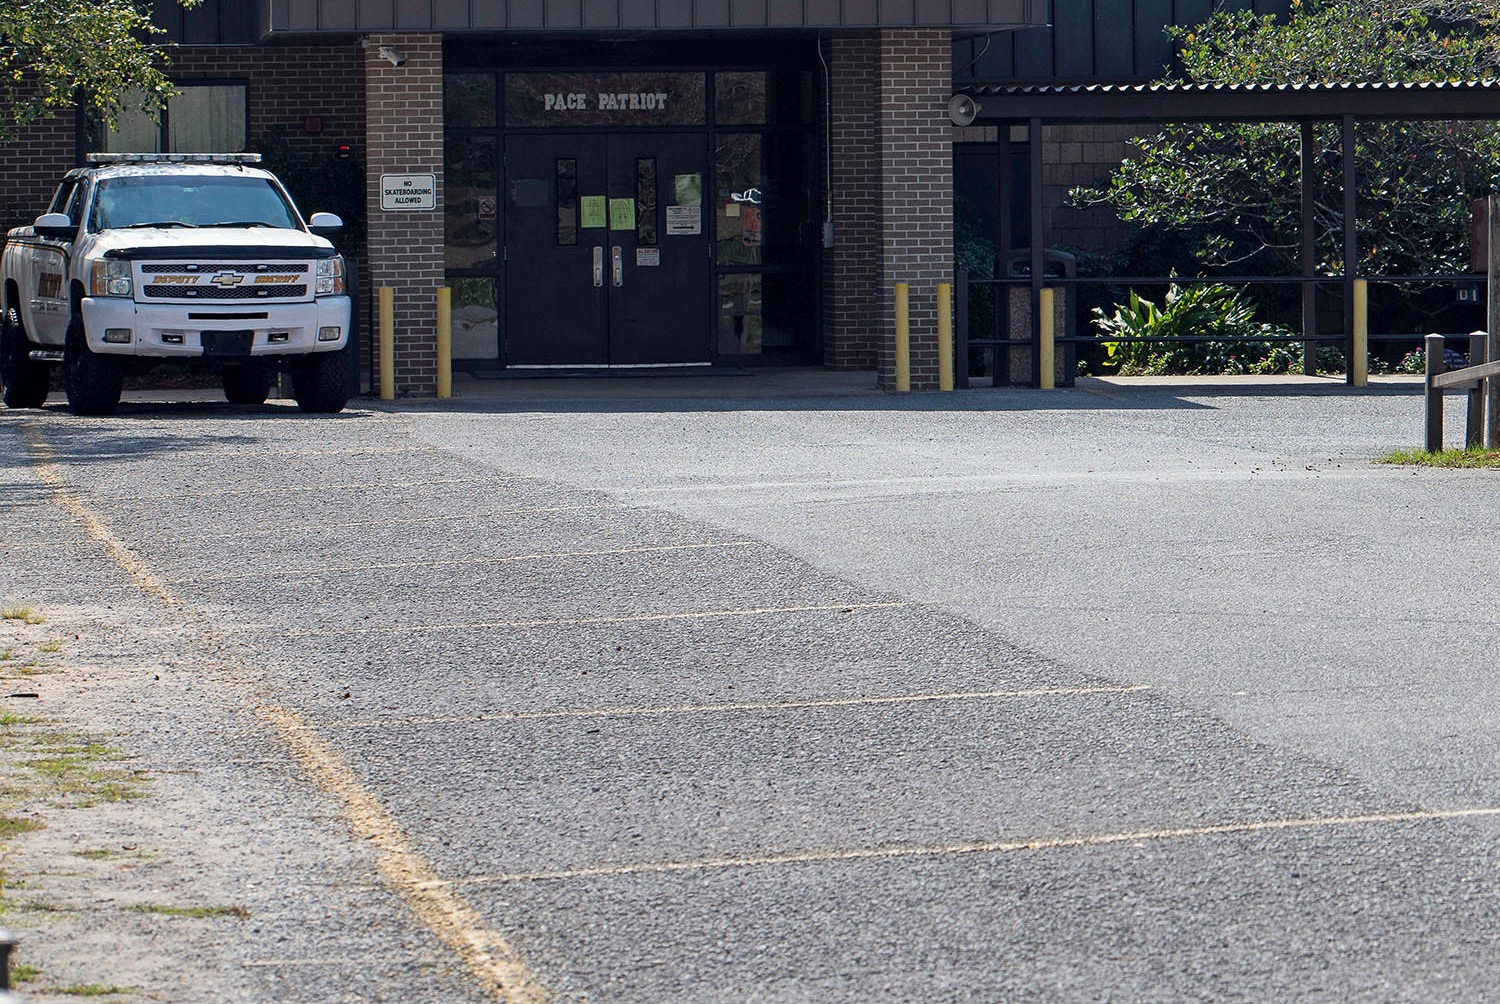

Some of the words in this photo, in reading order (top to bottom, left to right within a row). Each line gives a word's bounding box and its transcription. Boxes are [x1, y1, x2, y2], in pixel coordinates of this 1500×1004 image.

[544, 93, 586, 110] PACE
[598, 93, 667, 110] PATRIOT
[384, 188, 432, 196] SKATEBOARDING
[152, 275, 201, 284] DEPUTY
